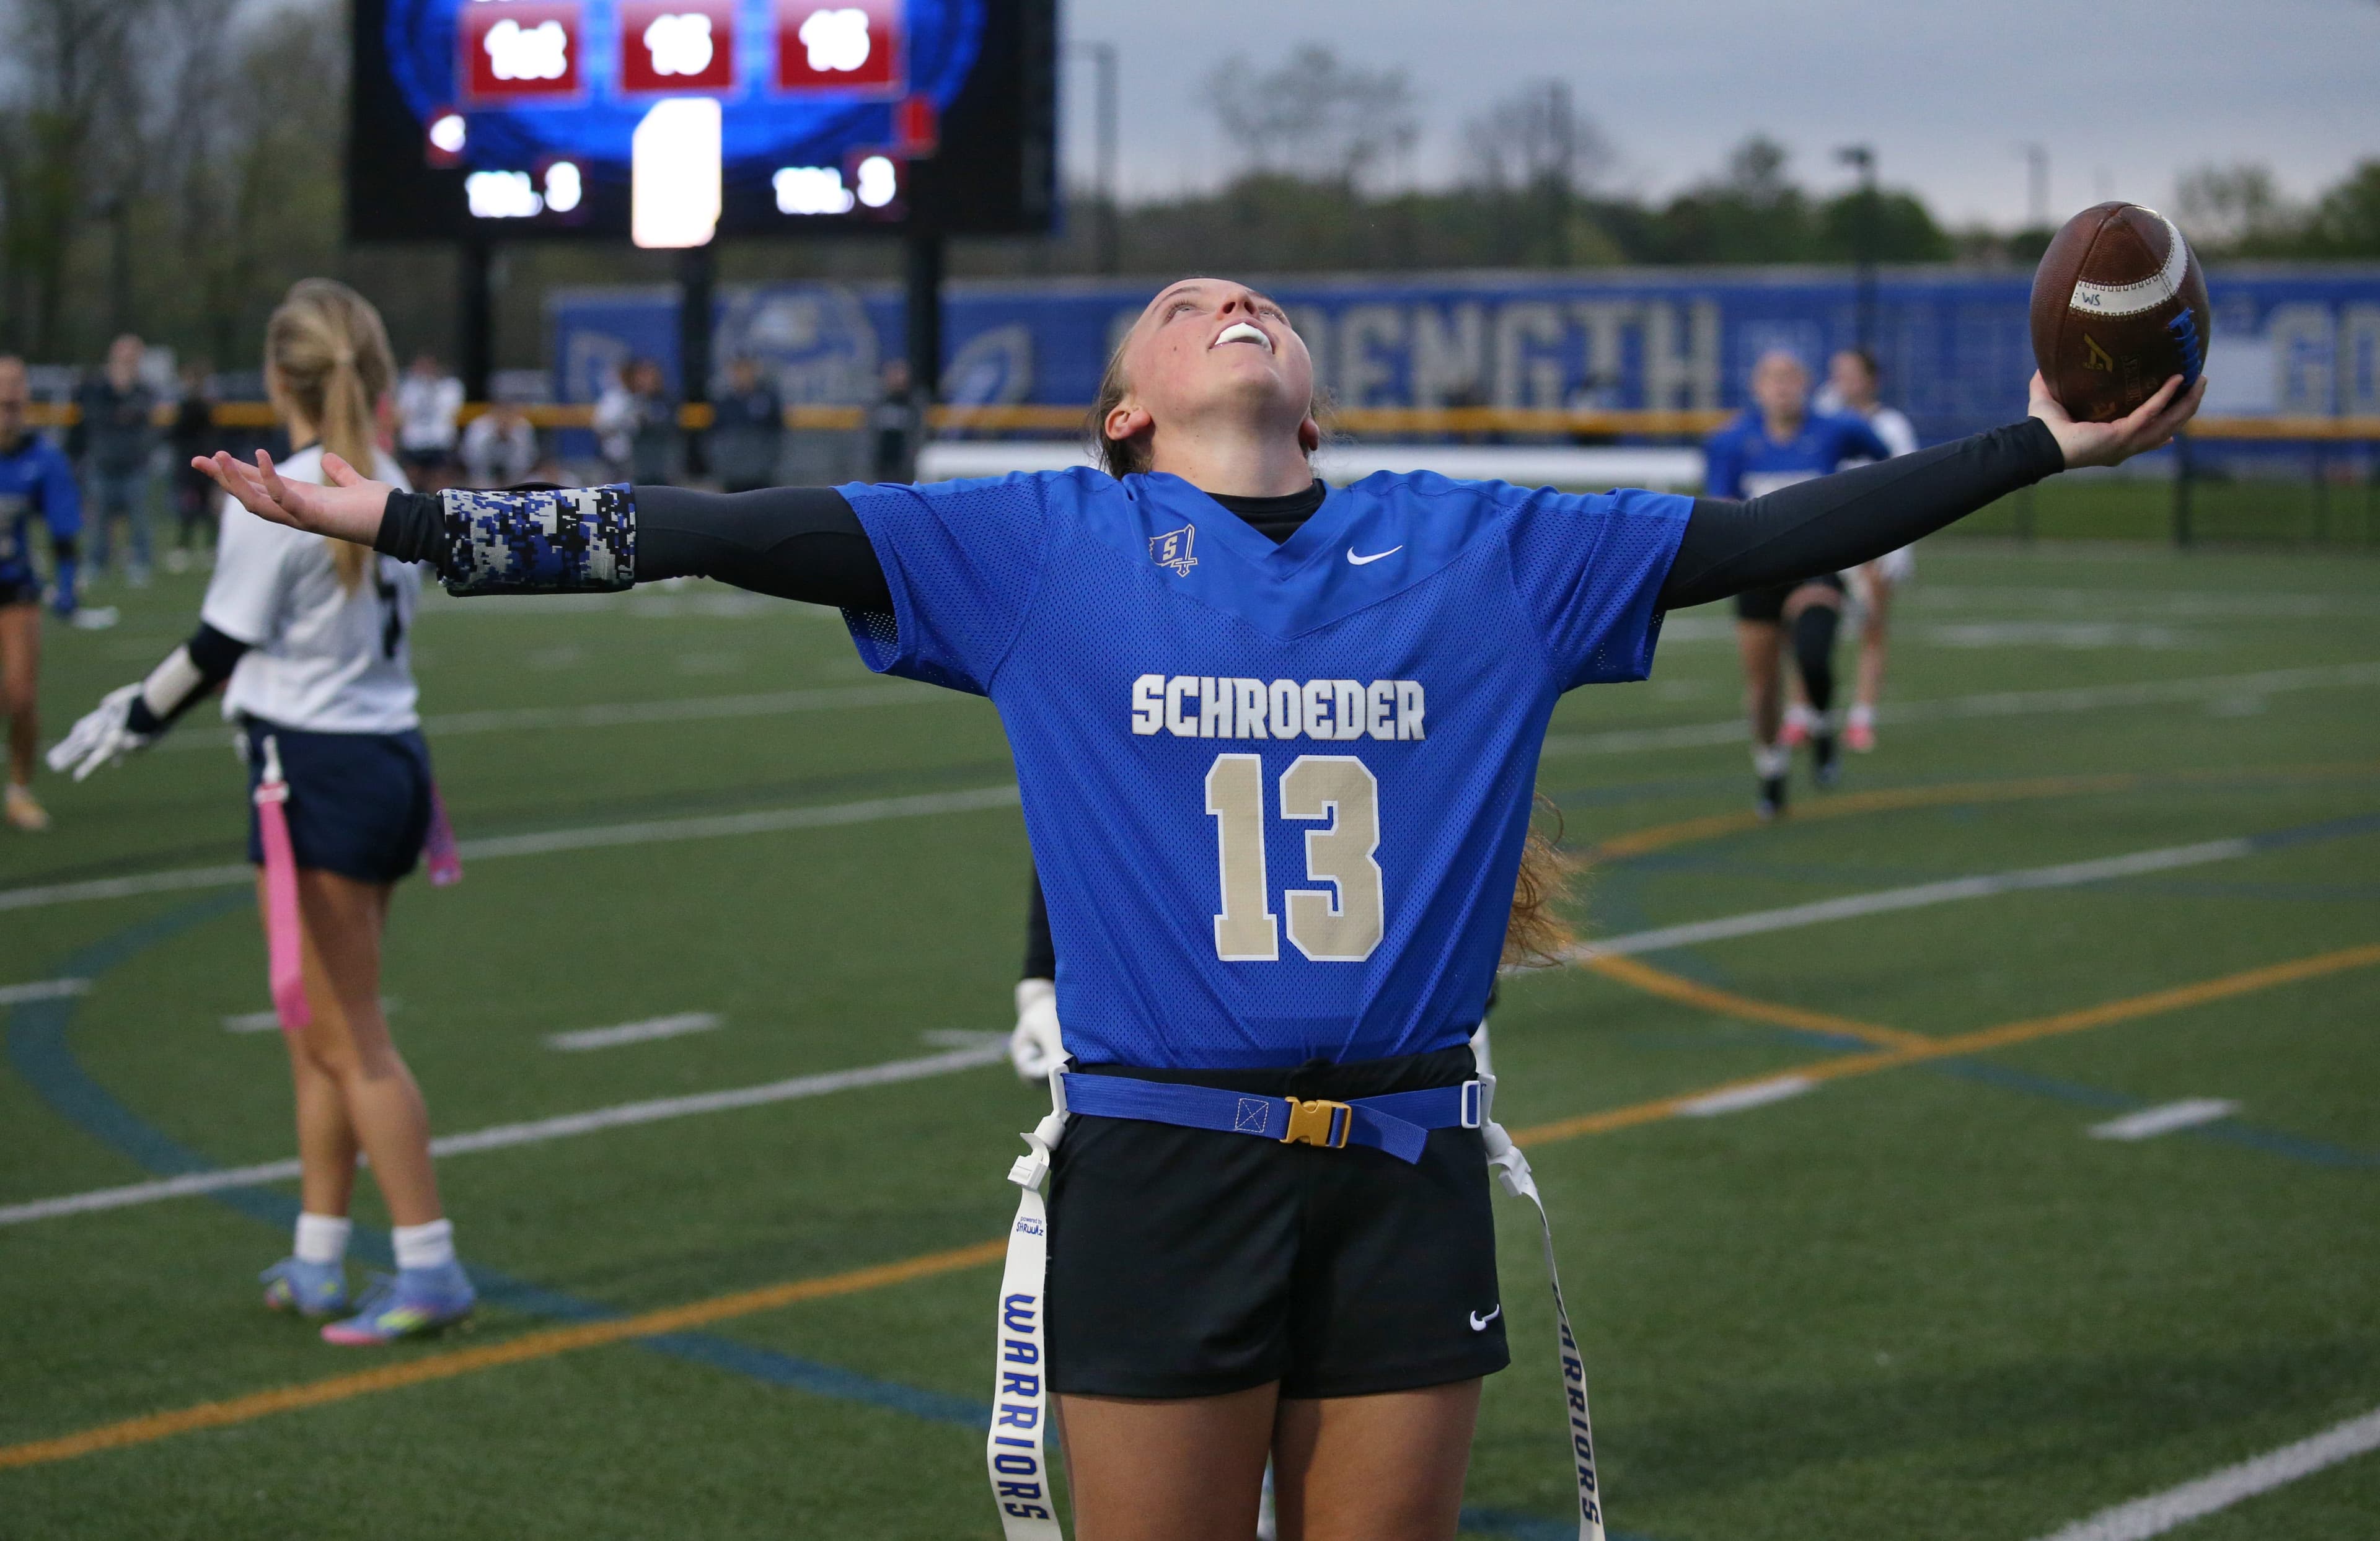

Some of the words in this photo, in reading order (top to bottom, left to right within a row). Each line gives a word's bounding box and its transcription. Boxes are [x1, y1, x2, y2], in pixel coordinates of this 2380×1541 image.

[1107, 302, 1722, 410] ENGTH
[1163, 535, 1178, 561] S
[1131, 673, 1426, 741] SCHROEDER
[1205, 753, 1385, 962] 13
[994, 1293, 1051, 1521] WARRIORS
